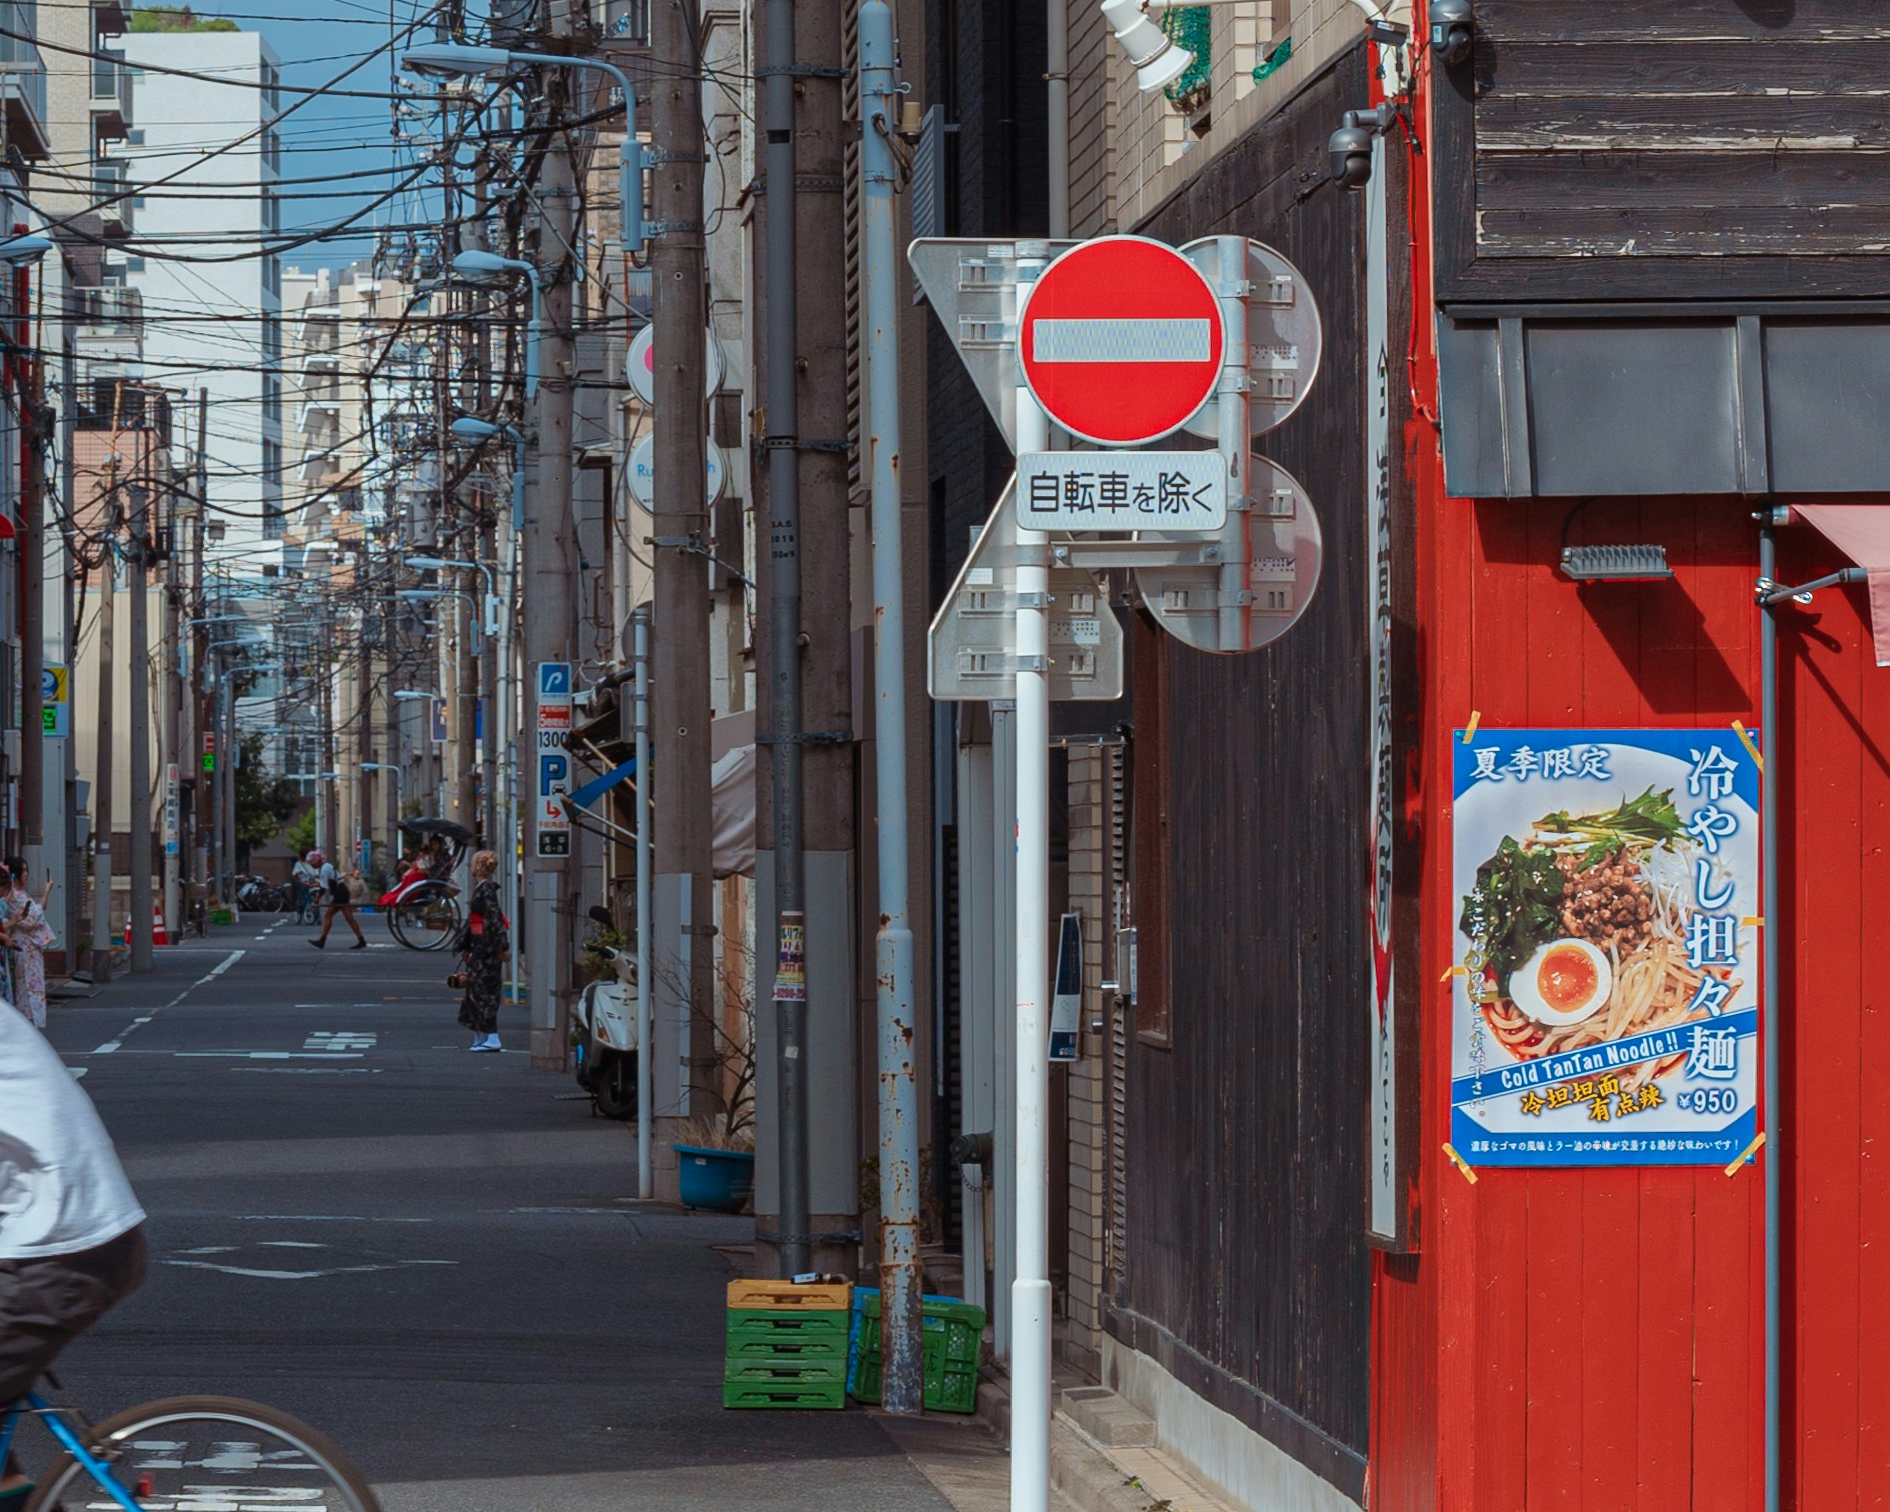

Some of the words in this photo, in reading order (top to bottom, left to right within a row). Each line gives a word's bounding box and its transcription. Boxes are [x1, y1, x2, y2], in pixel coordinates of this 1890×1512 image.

[1029, 470, 1213, 515] 自転車を除く
[540, 754, 567, 797] P
[1469, 744, 1612, 782] 夏季限定
[1686, 744, 1740, 1082] 冷やし担々麺
[1501, 1064, 1538, 1090] Cold
[1541, 1051, 1604, 1079] TanTan
[1588, 1083, 1665, 1122] 有点辣
[1678, 1089, 1736, 1113] ¥950
